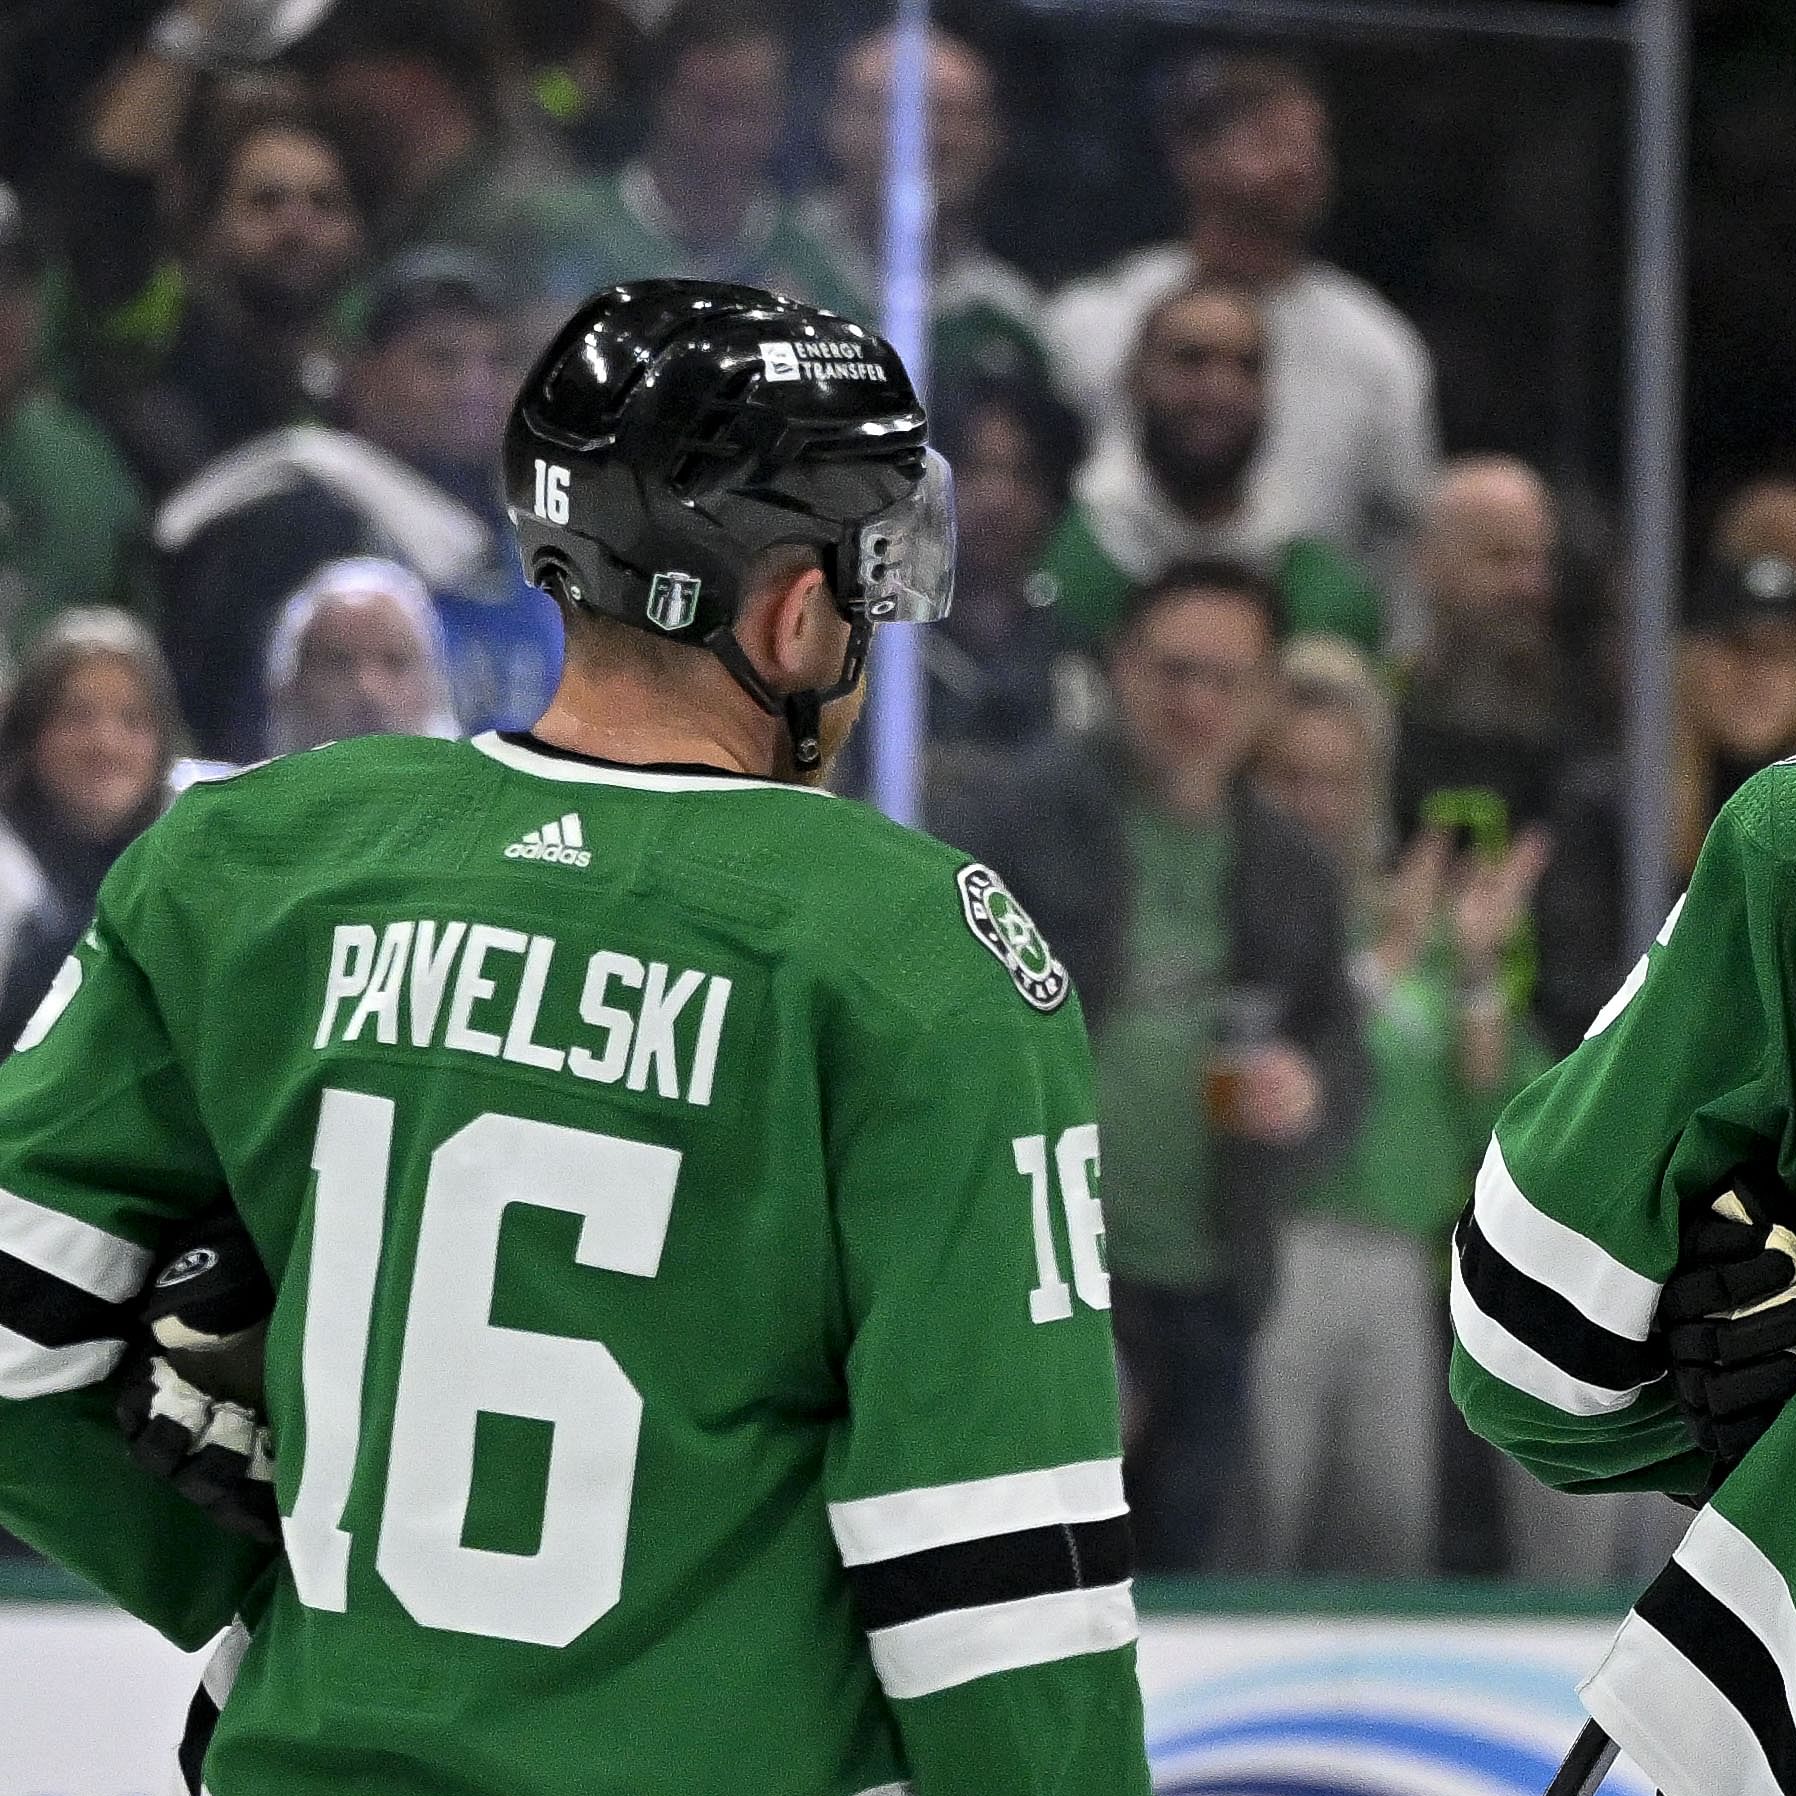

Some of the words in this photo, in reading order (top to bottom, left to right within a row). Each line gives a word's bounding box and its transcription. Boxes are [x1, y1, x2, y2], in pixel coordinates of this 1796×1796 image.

[797, 342, 864, 360] ENERGY
[800, 362, 887, 382] TRANSFER
[534, 459, 571, 525] 16
[504, 842, 592, 868] adidas
[314, 919, 733, 1106] PAVELSKI
[280, 1087, 683, 1648] 16
